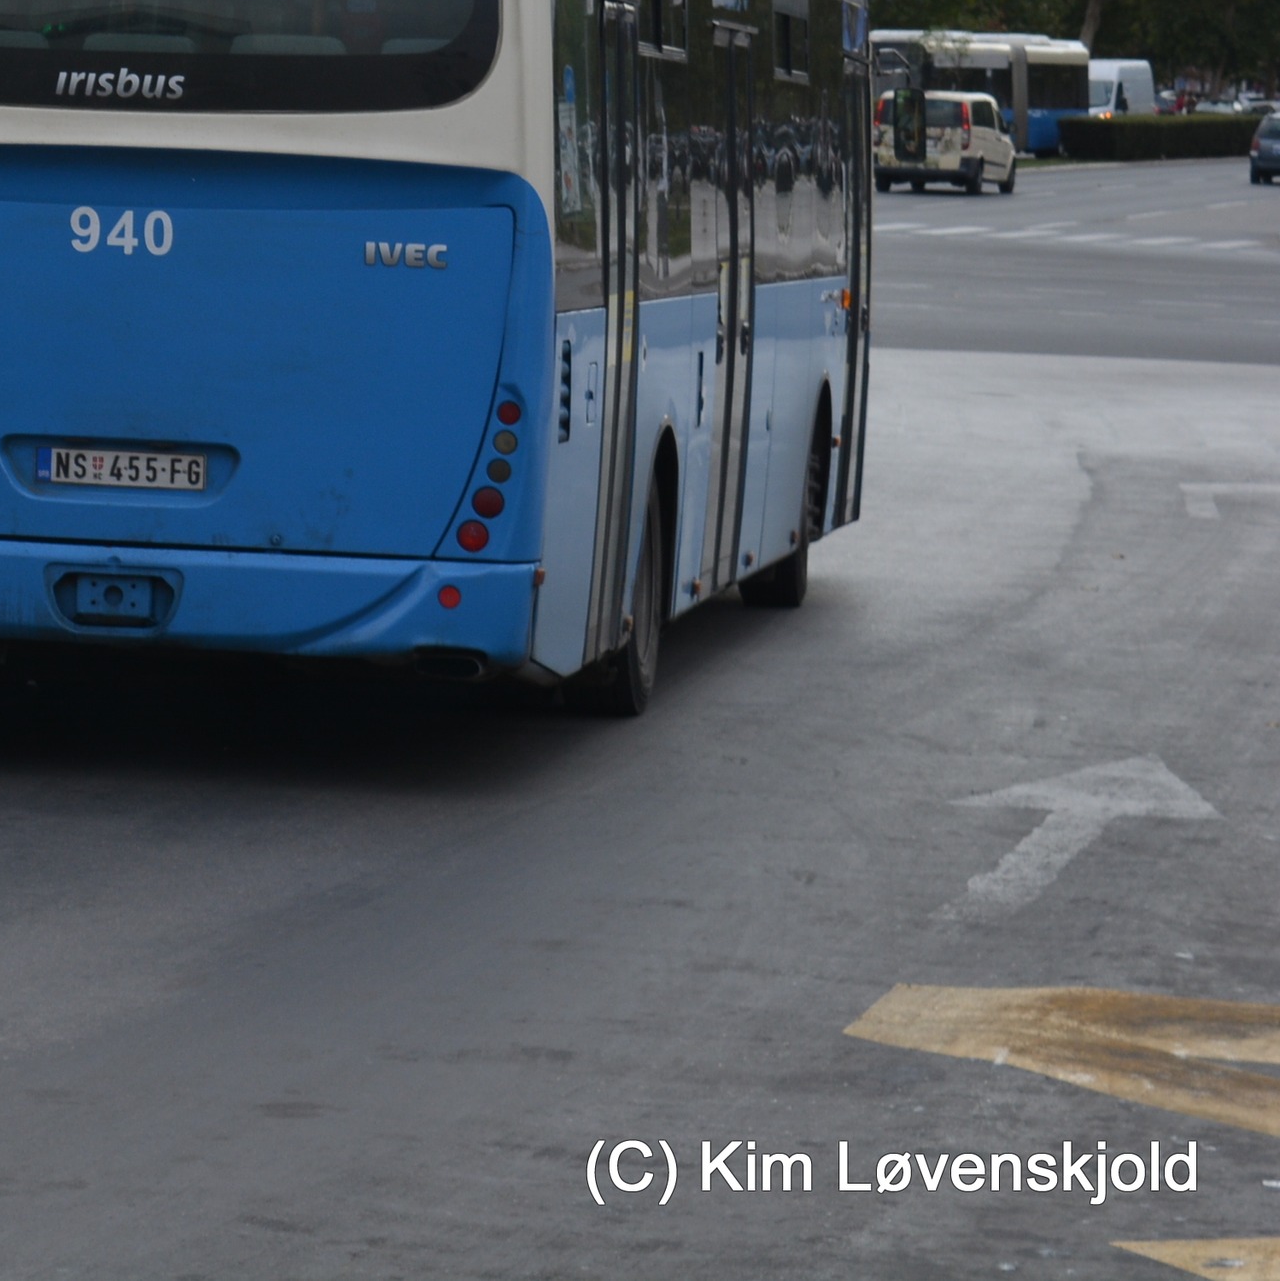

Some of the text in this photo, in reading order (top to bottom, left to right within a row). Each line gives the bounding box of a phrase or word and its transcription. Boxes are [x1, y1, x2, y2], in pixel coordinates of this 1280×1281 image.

[55, 67, 185, 99] irisbus
[69, 205, 173, 256] 940
[364, 240, 449, 269] IVEC
[55, 451, 87, 479] NS
